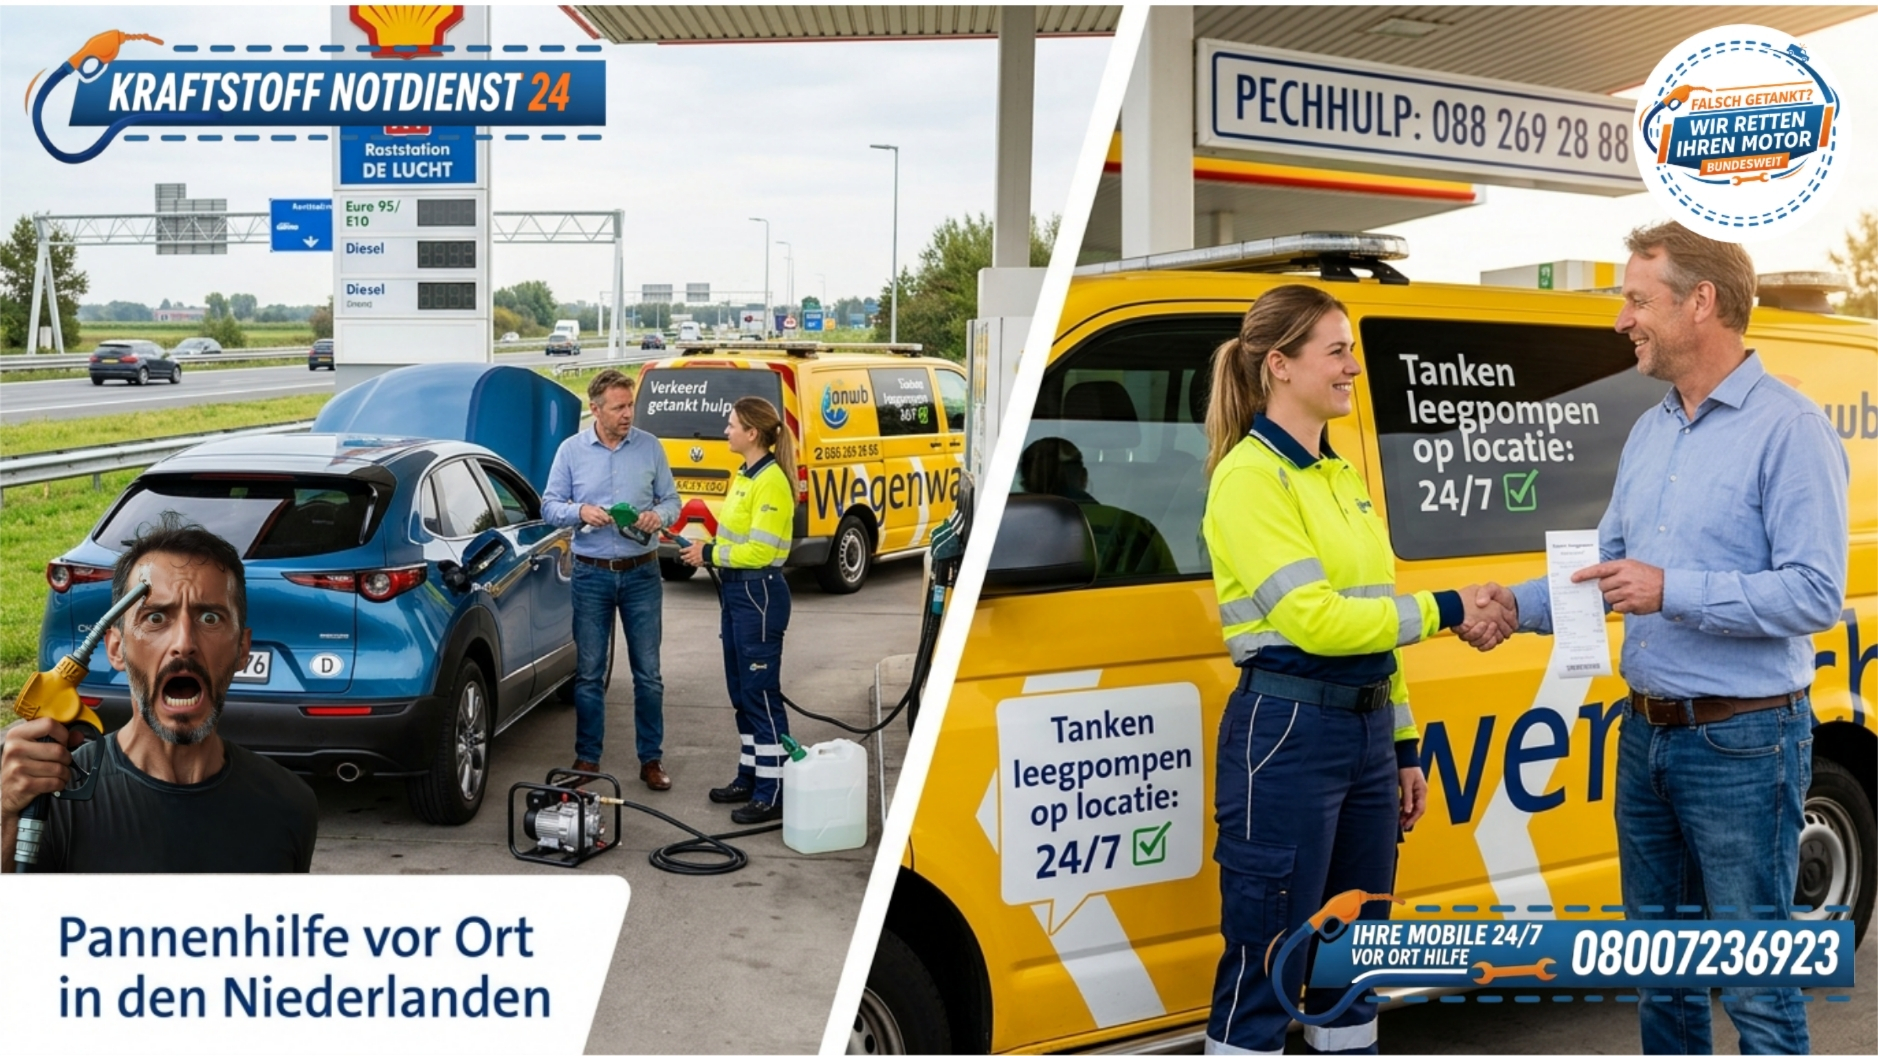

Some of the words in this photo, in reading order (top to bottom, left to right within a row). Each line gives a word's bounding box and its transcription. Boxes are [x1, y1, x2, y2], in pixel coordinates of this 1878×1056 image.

[1236, 73, 1422, 142] PECHHULP:
[1432, 99, 1487, 148] 088
[1497, 107, 1547, 153] 269
[1556, 116, 1590, 160] 28
[1599, 121, 1630, 164] 88
[365, 143, 450, 157] Raststation
[362, 162, 387, 179] DE
[392, 162, 453, 179] LUCHT
[346, 216, 370, 227] E10
[346, 243, 385, 255] Diesel
[346, 283, 385, 295] Diesel
[1399, 353, 1516, 387] Tanken
[650, 380, 708, 395] Verkeerd
[647, 398, 699, 416] getankt
[701, 398, 732, 418] hulp
[1406, 390, 1600, 434] leegpompen
[1413, 438, 1454, 473] op
[1460, 430, 1575, 463] locatie:
[1418, 474, 1493, 517] 24/7
[321, 658, 334, 674] D
[1051, 710, 1155, 743] Tanken
[1013, 748, 1192, 791] leegpompen
[1031, 802, 1068, 832] op
[1077, 784, 1179, 820] locatie:
[1036, 834, 1121, 880] 24/7
